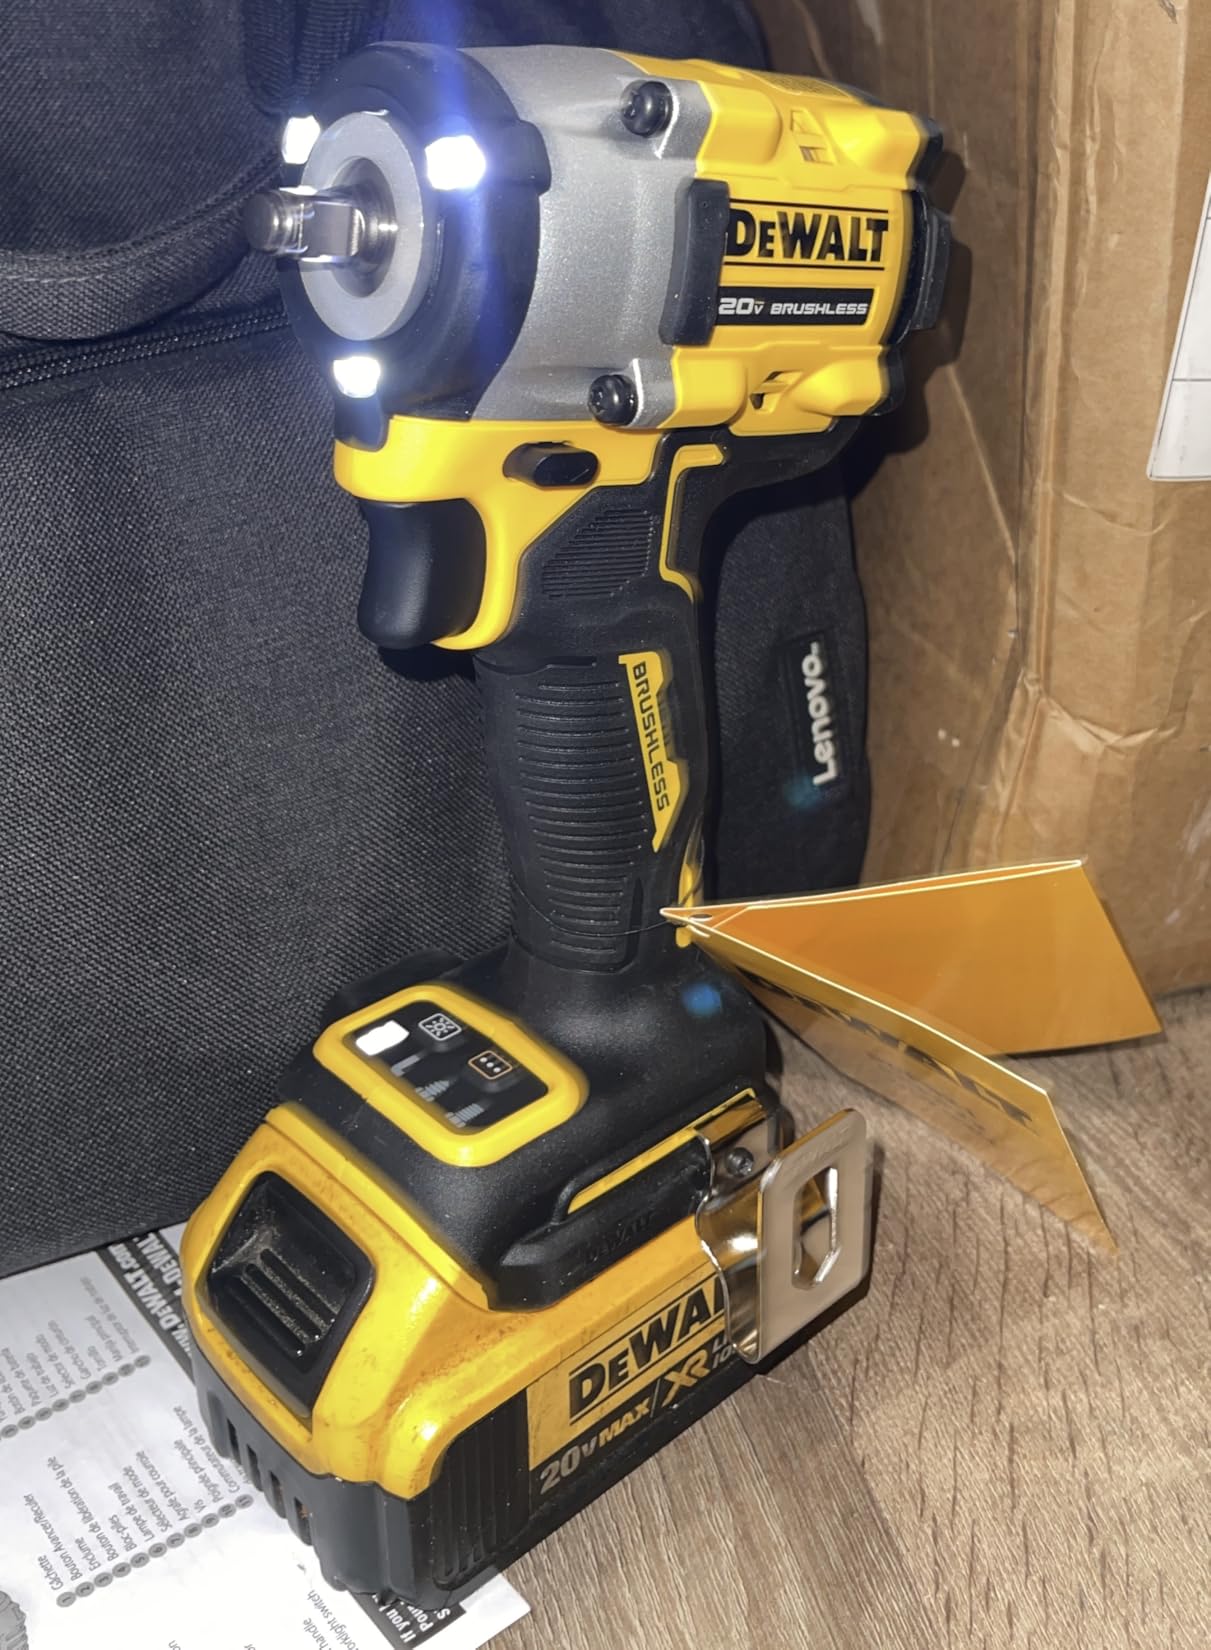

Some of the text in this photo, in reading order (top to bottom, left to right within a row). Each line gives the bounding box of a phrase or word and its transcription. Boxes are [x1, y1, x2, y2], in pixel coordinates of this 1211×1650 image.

[770, 303, 868, 316] BRUSHLESS
[632, 661, 670, 812] BRUSHLESS
[569, 1275, 724, 1418] DEWA
[661, 1349, 711, 1408] XR
[59, 1476, 73, 1489] de
[136, 1487, 150, 1499] de
[124, 1504, 138, 1516] de
[87, 1520, 102, 1534] de
[132, 1514, 156, 1543] Lampe
[74, 1536, 102, 1572] Enclume
[95, 1531, 120, 1562] Bouton
[59, 1550, 84, 1582] Bouton
[307, 1590, 359, 1650] orklight switch
[386, 1608, 411, 1632] you
